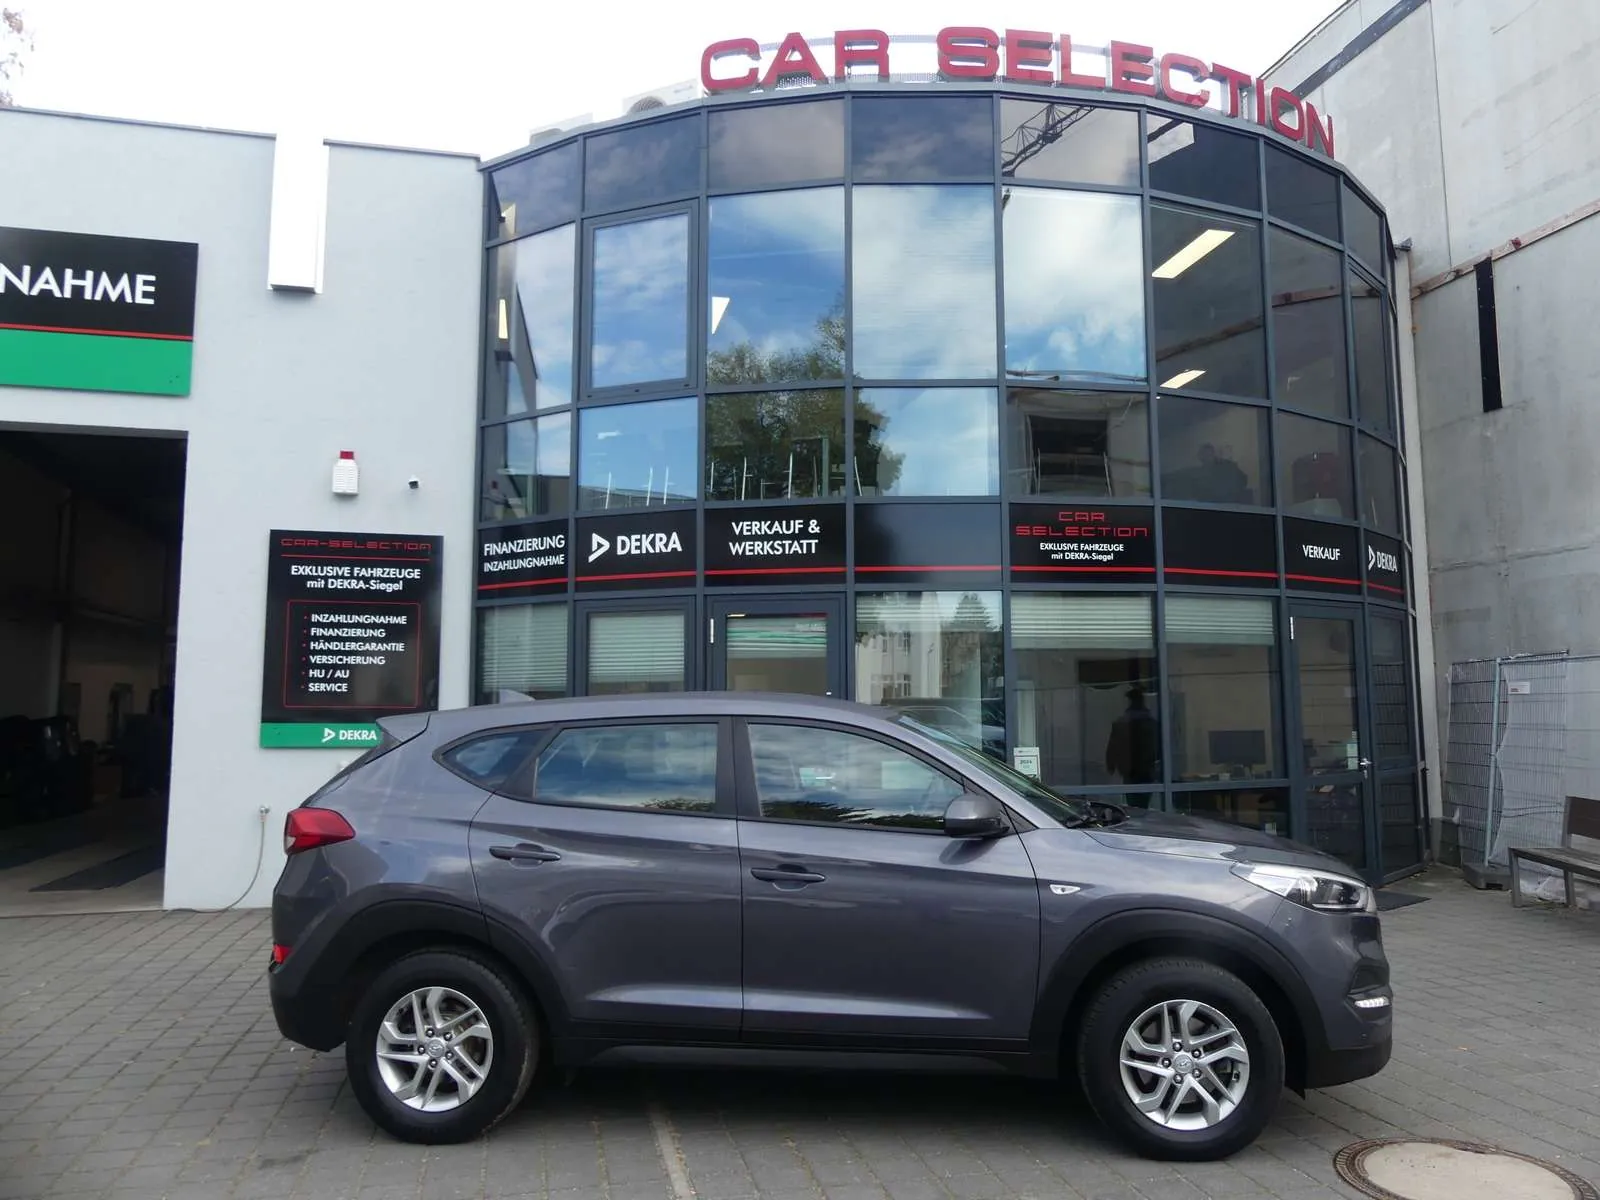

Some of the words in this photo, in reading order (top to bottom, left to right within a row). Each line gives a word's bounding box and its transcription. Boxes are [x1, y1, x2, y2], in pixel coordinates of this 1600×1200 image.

[700, 29, 890, 90] CAR
[936, 26, 1335, 159] SELECTION
[1058, 511, 1105, 522] CAR
[731, 520, 804, 536] VERKAUF
[808, 519, 821, 534] &
[1015, 526, 1148, 537] SELECTION
[280, 537, 432, 551] CAR-SELECTION
[483, 534, 566, 557] FINANZIERUNG
[616, 531, 683, 556] DEKRA
[728, 539, 819, 556] WERKSTATT
[1039, 542, 1079, 551] EXKLUSIVE
[1080, 543, 1125, 552] FAHRZEUGE
[1051, 552, 1063, 560] mit
[1064, 552, 1114, 562] DEKRA-Siegel
[1302, 544, 1341, 561] VERKAUF
[483, 554, 565, 573] INZAHLUNGNAHME
[1376, 551, 1399, 573] DEKRA
[290, 565, 351, 577] EXKLUSIVE
[353, 566, 421, 579] FAHRZEUGE
[306, 578, 325, 589] mit
[327, 578, 404, 593] DEKRA-Siegel
[311, 613, 408, 625] INZAHLUNGNAHME
[310, 627, 386, 638] FINANZIERUNG
[310, 641, 405, 652] HÄNDLERGARANTIE
[309, 655, 386, 665] VERSICHERUNG
[308, 669, 325, 678] HU
[334, 669, 350, 678] AU
[308, 683, 348, 692] SERVICE
[339, 729, 377, 741] DEKRA
